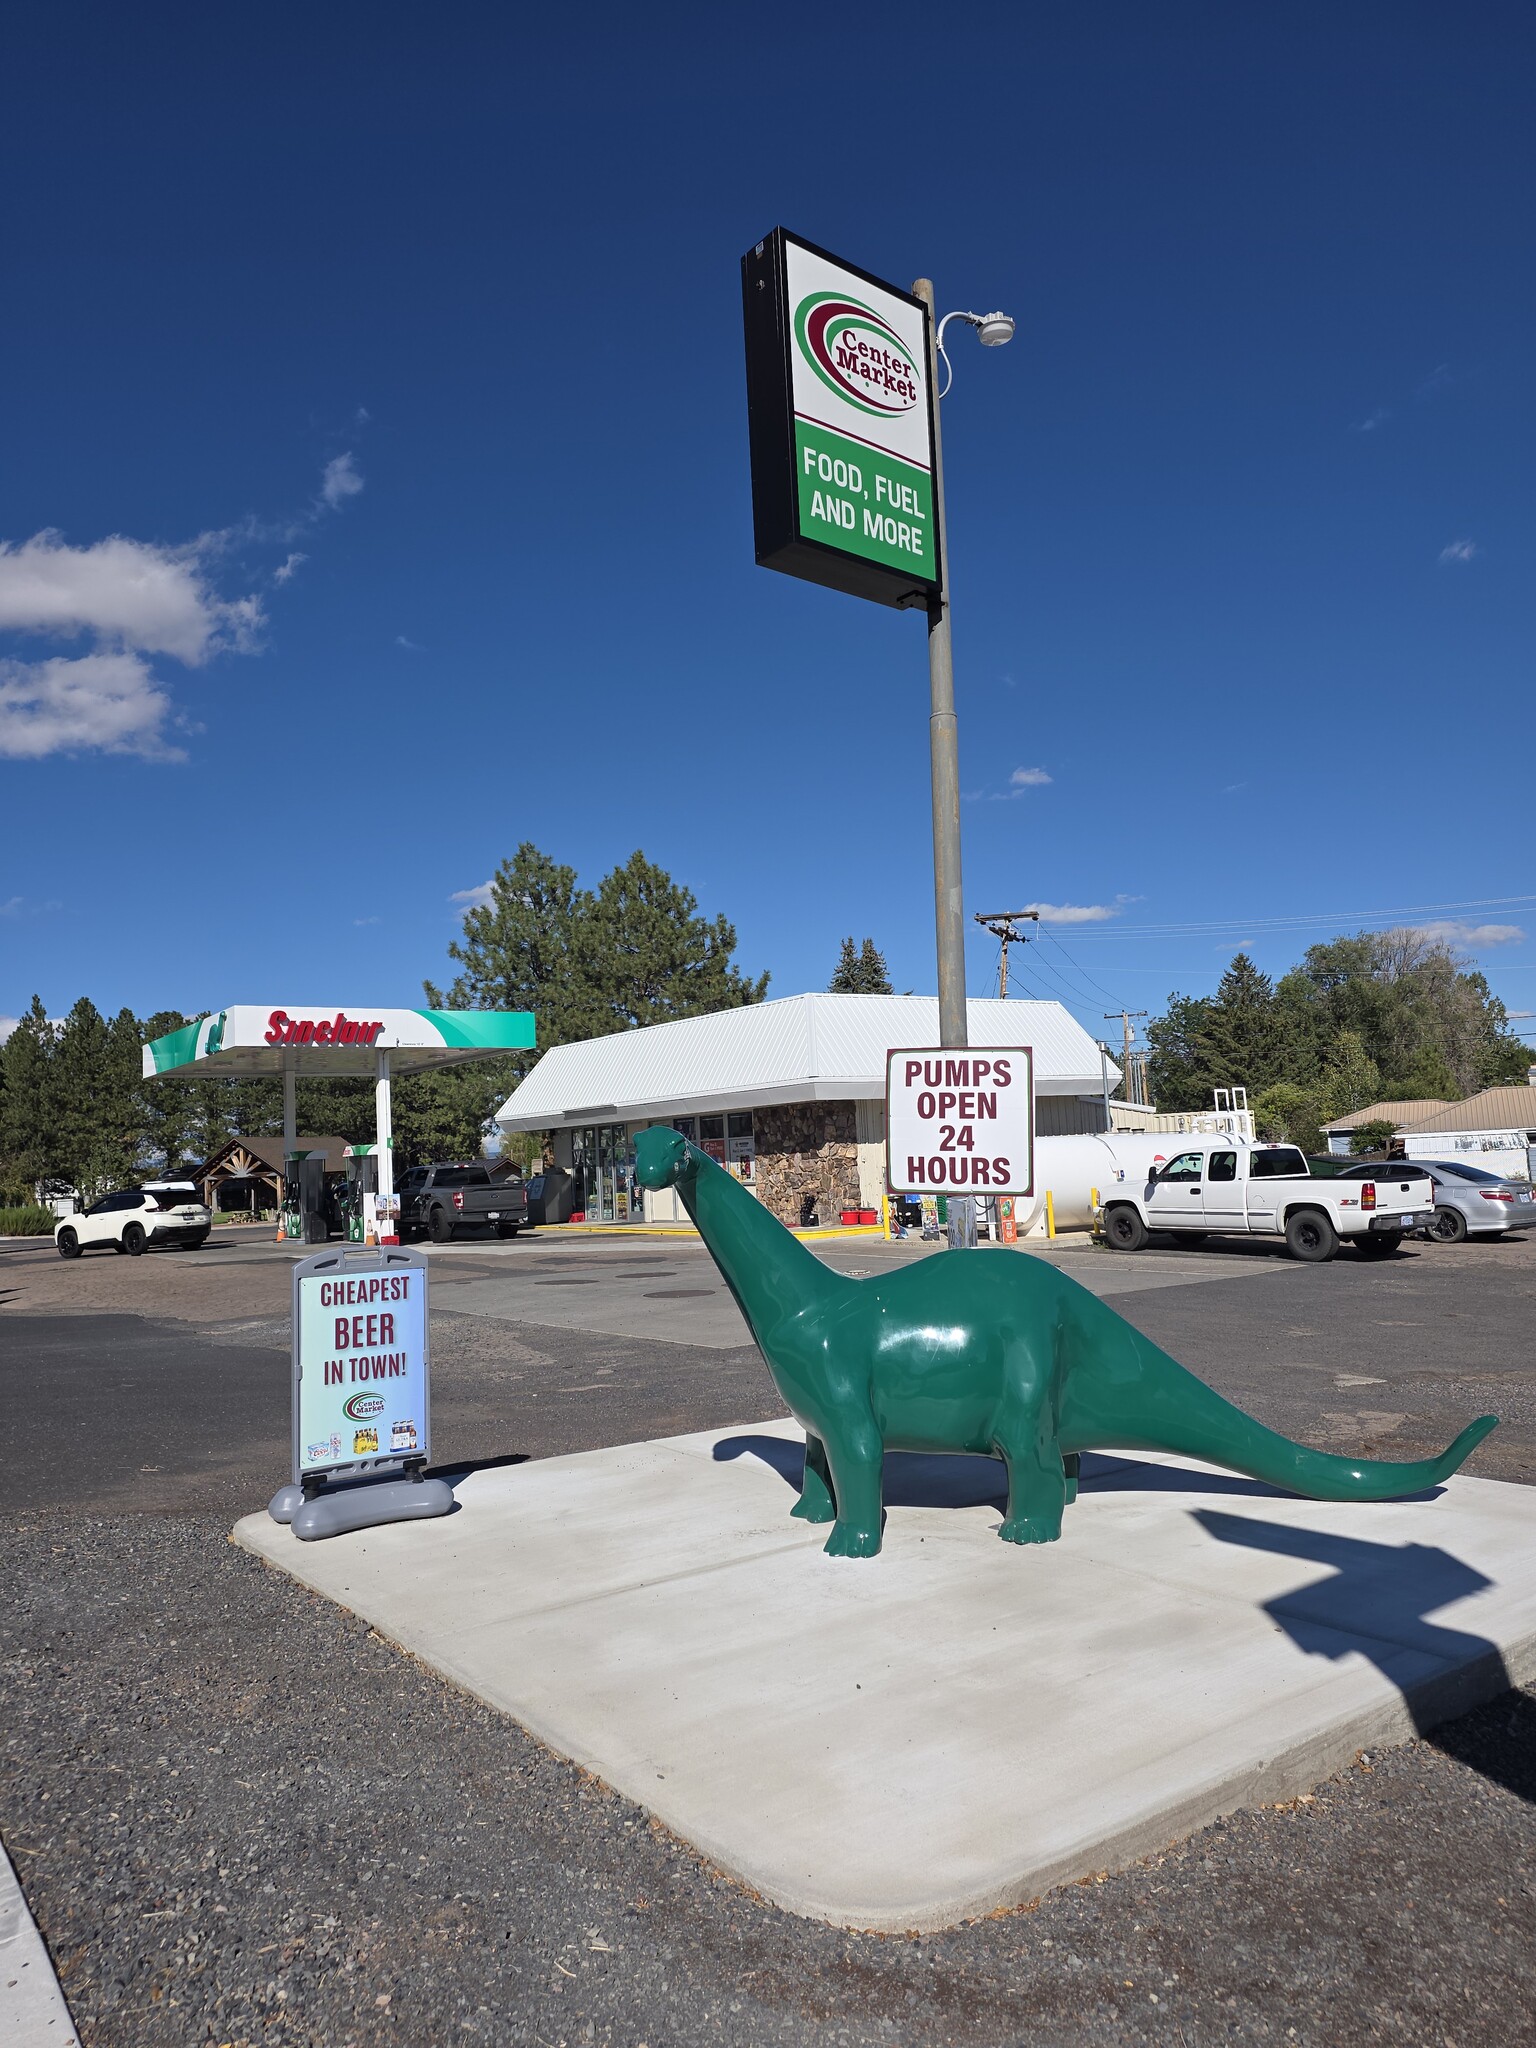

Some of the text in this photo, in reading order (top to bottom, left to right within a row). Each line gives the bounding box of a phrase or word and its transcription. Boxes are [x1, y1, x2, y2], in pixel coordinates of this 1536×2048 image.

[842, 329, 912, 379] Center
[836, 346, 917, 401] Market
[803, 447, 926, 520] FOOD, FUEL
[811, 490, 923, 556] AND MORE
[264, 1010, 384, 1044] Sinclair
[905, 1059, 1012, 1087] PUMPS
[917, 1092, 997, 1119] OPEN
[939, 1125, 975, 1152] 24
[907, 1156, 1011, 1185] HOURS
[321, 1276, 410, 1307] CHEAPEST
[335, 1313, 394, 1350] BEER
[324, 1353, 406, 1385] IN TOWN!
[356, 1404, 384, 1414] Market
[358, 1400, 384, 1408] Center
